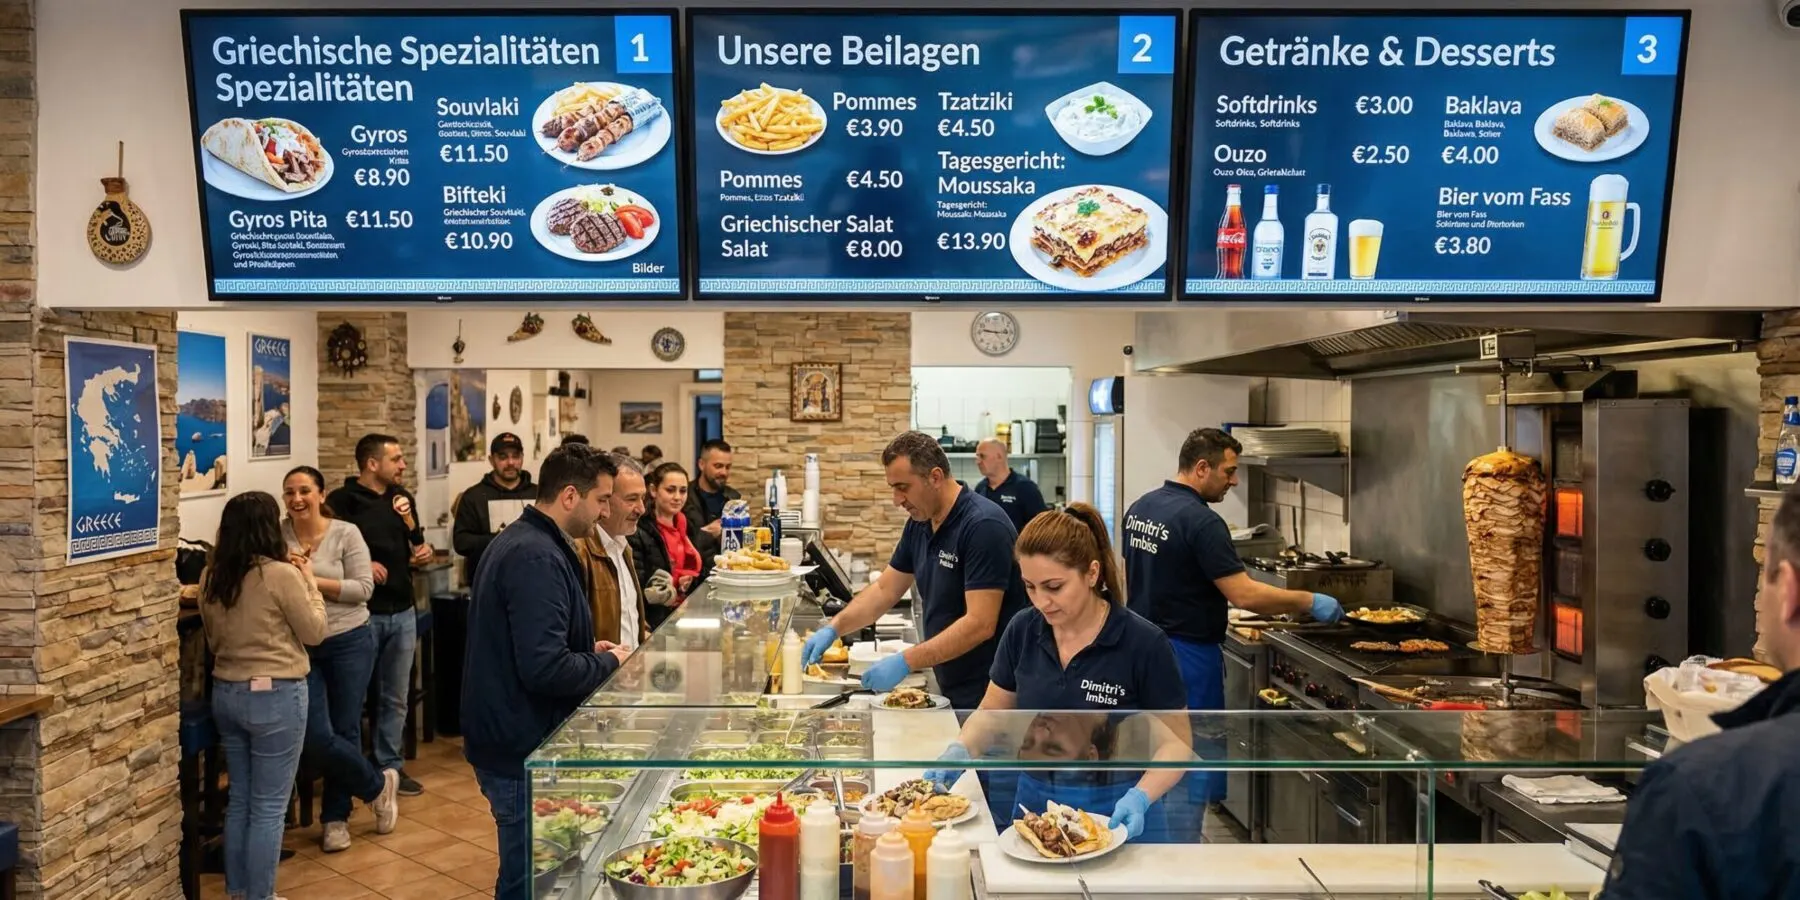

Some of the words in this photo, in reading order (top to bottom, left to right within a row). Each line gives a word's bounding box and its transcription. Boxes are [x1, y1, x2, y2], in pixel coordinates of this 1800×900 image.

[212, 35, 392, 65] Griechische
[401, 35, 600, 70] Spezialitäten
[631, 34, 649, 62] 1
[718, 35, 832, 66] Unsere
[842, 35, 981, 72] Beilagen
[1132, 34, 1153, 63] 2
[1219, 35, 1370, 66] Getränke
[1378, 36, 1404, 66] &
[1415, 35, 1556, 66] Desserts
[1637, 34, 1657, 64] 3
[216, 73, 414, 107] Spezialitäten
[437, 97, 519, 116] Souvlaki
[833, 92, 917, 112] Pommes
[938, 91, 1014, 112] Tzatziki
[1216, 94, 1318, 114] Softdrinks
[1355, 95, 1413, 114] €3.00
[1445, 95, 1522, 115] Baklava
[846, 118, 903, 138] €3.90
[937, 118, 995, 138] €4.50
[1215, 119, 1257, 128] Softdrinks,
[1260, 119, 1300, 128] Softdrinks
[350, 124, 408, 146] Gyros
[440, 144, 509, 162] €11.50
[937, 151, 1066, 173] Tagesgericht:
[1214, 144, 1267, 163] Ouzo
[1352, 145, 1410, 164] €2.50
[1441, 145, 1499, 164] €4.00
[354, 168, 411, 187] €8.90
[720, 170, 803, 188] Pommes
[846, 170, 904, 189] €4.50
[1213, 168, 1234, 177] Ouzo
[443, 185, 506, 204] Bifteki
[938, 176, 1036, 195] Moussaka
[720, 193, 753, 202] Pommes,
[937, 201, 988, 210] Tagesgericht:
[1439, 187, 1479, 206] Bier
[1483, 191, 1524, 206] vom
[1530, 187, 1572, 206] Fass
[229, 210, 285, 231] Gyros
[290, 210, 328, 228] Pita
[346, 210, 413, 229] €11.50
[720, 214, 842, 233] Griechischer
[846, 214, 894, 233] Salat
[1436, 210, 1452, 218] Bier
[1471, 210, 1488, 218] Fass
[445, 232, 514, 250] €10.90
[721, 239, 769, 257] Salat
[846, 240, 903, 258] €8.00
[937, 232, 1006, 250] €13.90
[1435, 236, 1492, 255] €3.80
[632, 263, 665, 274] Bilder
[255, 338, 287, 357] GREECE
[76, 512, 121, 533] GREECE
[1125, 515, 1170, 541] Dimitri's
[1130, 533, 1158, 554] Imbiss
[1080, 679, 1126, 696] Dimitri's
[1085, 691, 1118, 705] Imbiss
